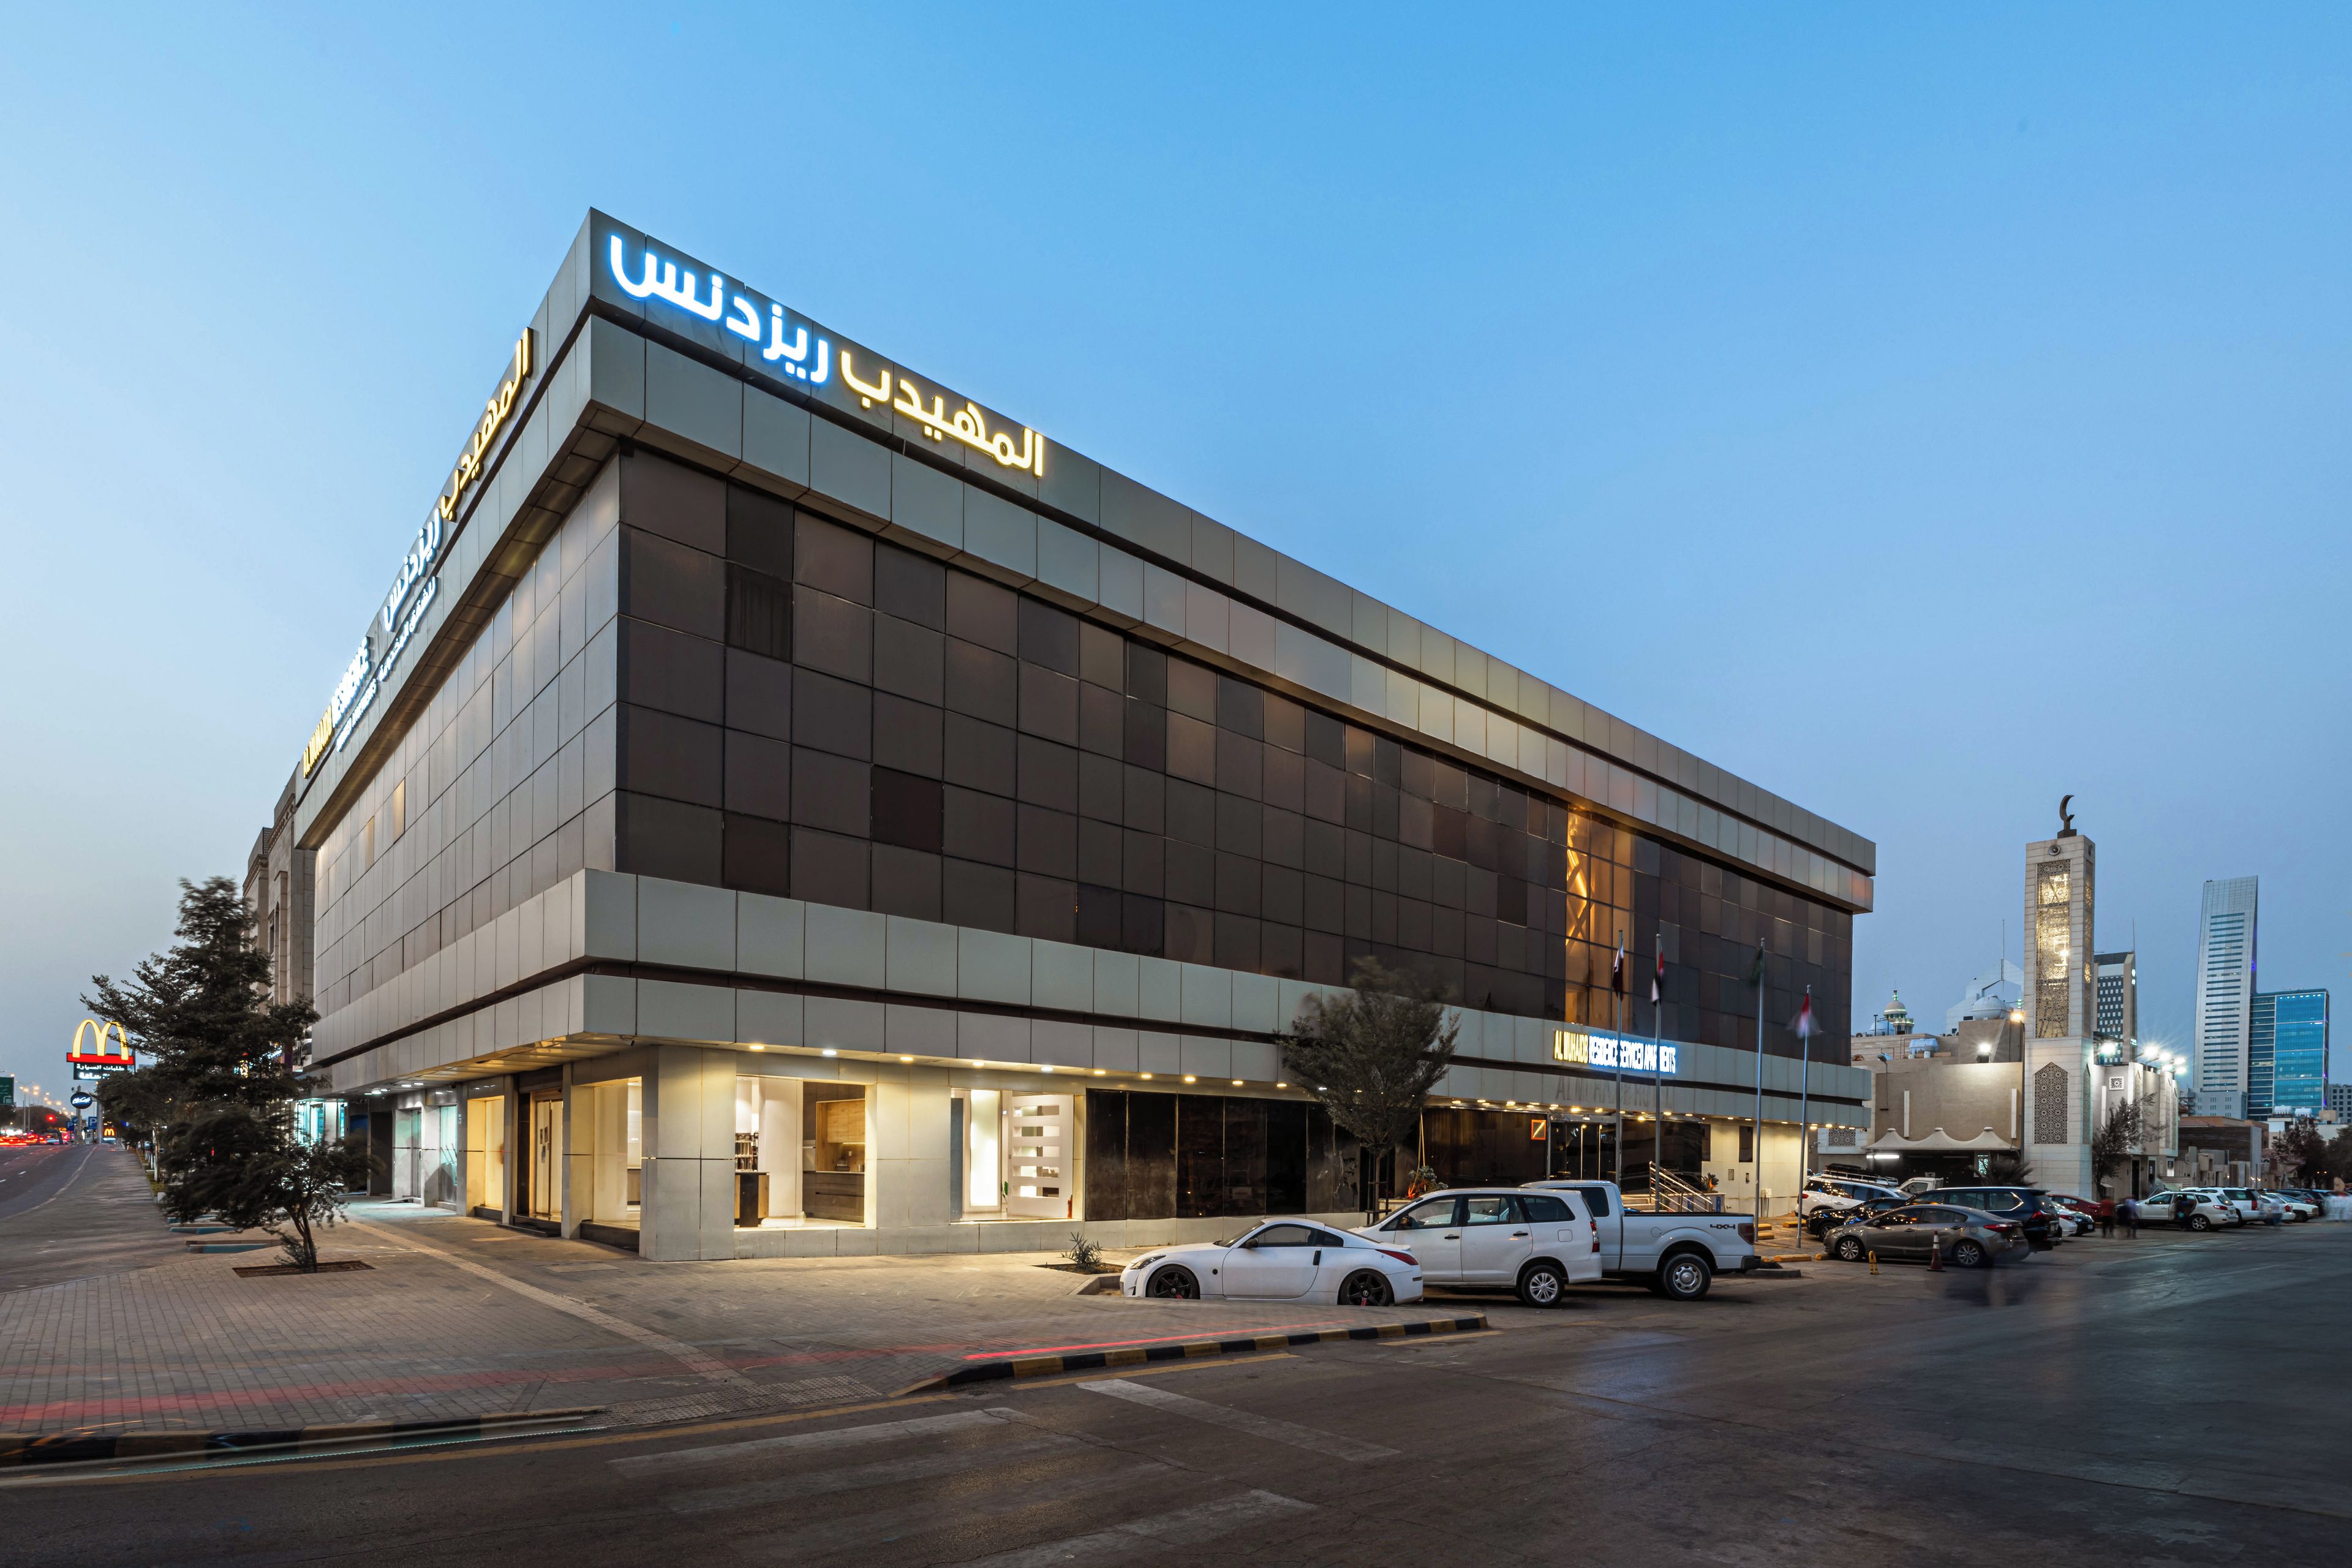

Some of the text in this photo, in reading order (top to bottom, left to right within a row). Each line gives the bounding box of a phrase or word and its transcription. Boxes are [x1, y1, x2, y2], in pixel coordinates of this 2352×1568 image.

[609, 234, 1045, 477] المهيدب ريزدنس
[383, 327, 530, 631] المهيدب ريزدنس
[1554, 1030, 1564, 1060] AL
